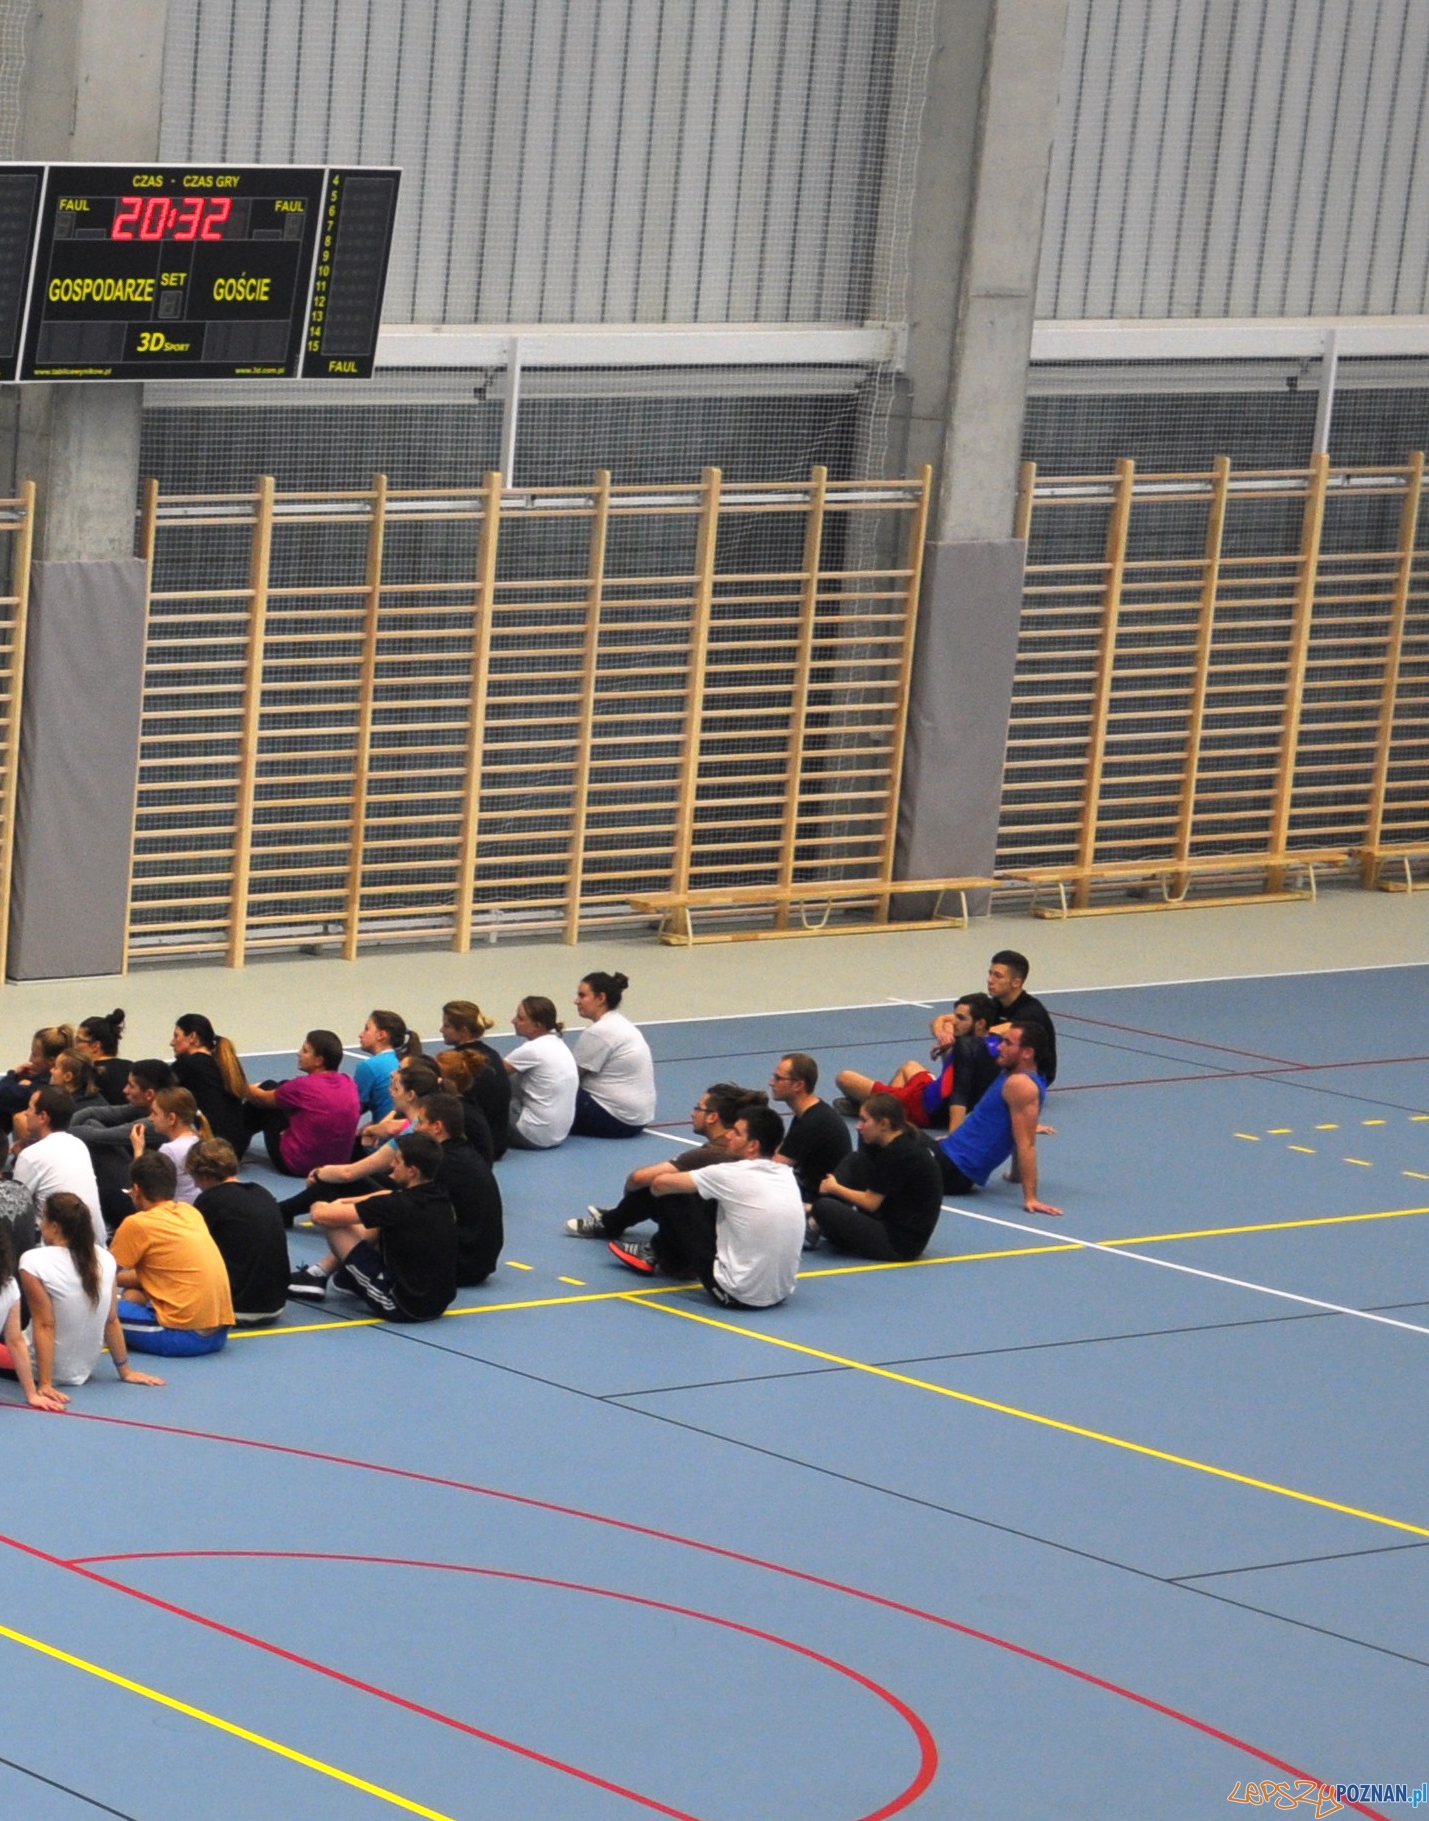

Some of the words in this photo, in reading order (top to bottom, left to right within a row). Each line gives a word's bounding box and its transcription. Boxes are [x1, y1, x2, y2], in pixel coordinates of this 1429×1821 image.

[132, 175, 163, 187] CZAS
[183, 175, 214, 187] CZAS
[216, 175, 240, 187] GRY
[332, 174, 340, 185] 4
[330, 190, 338, 201] 5
[59, 199, 90, 211] FAUL
[274, 200, 304, 212] FAUL
[328, 205, 336, 216] 6
[111, 196, 233, 240] 20:32
[327, 220, 334, 231] 7
[324, 235, 332, 247] 8
[322, 250, 330, 261] 9
[318, 265, 330, 276] 10
[160, 273, 187, 286] SET
[49, 278, 155, 301] GOSPODARZE
[213, 271, 271, 301] GOŚCIE
[316, 280, 327, 291] 11
[314, 296, 326, 307] 12
[312, 310, 323, 321] 13
[310, 326, 321, 337] 14
[137, 332, 165, 352] 3D
[308, 340, 319, 351] 15
[328, 360, 358, 373] FAUL
